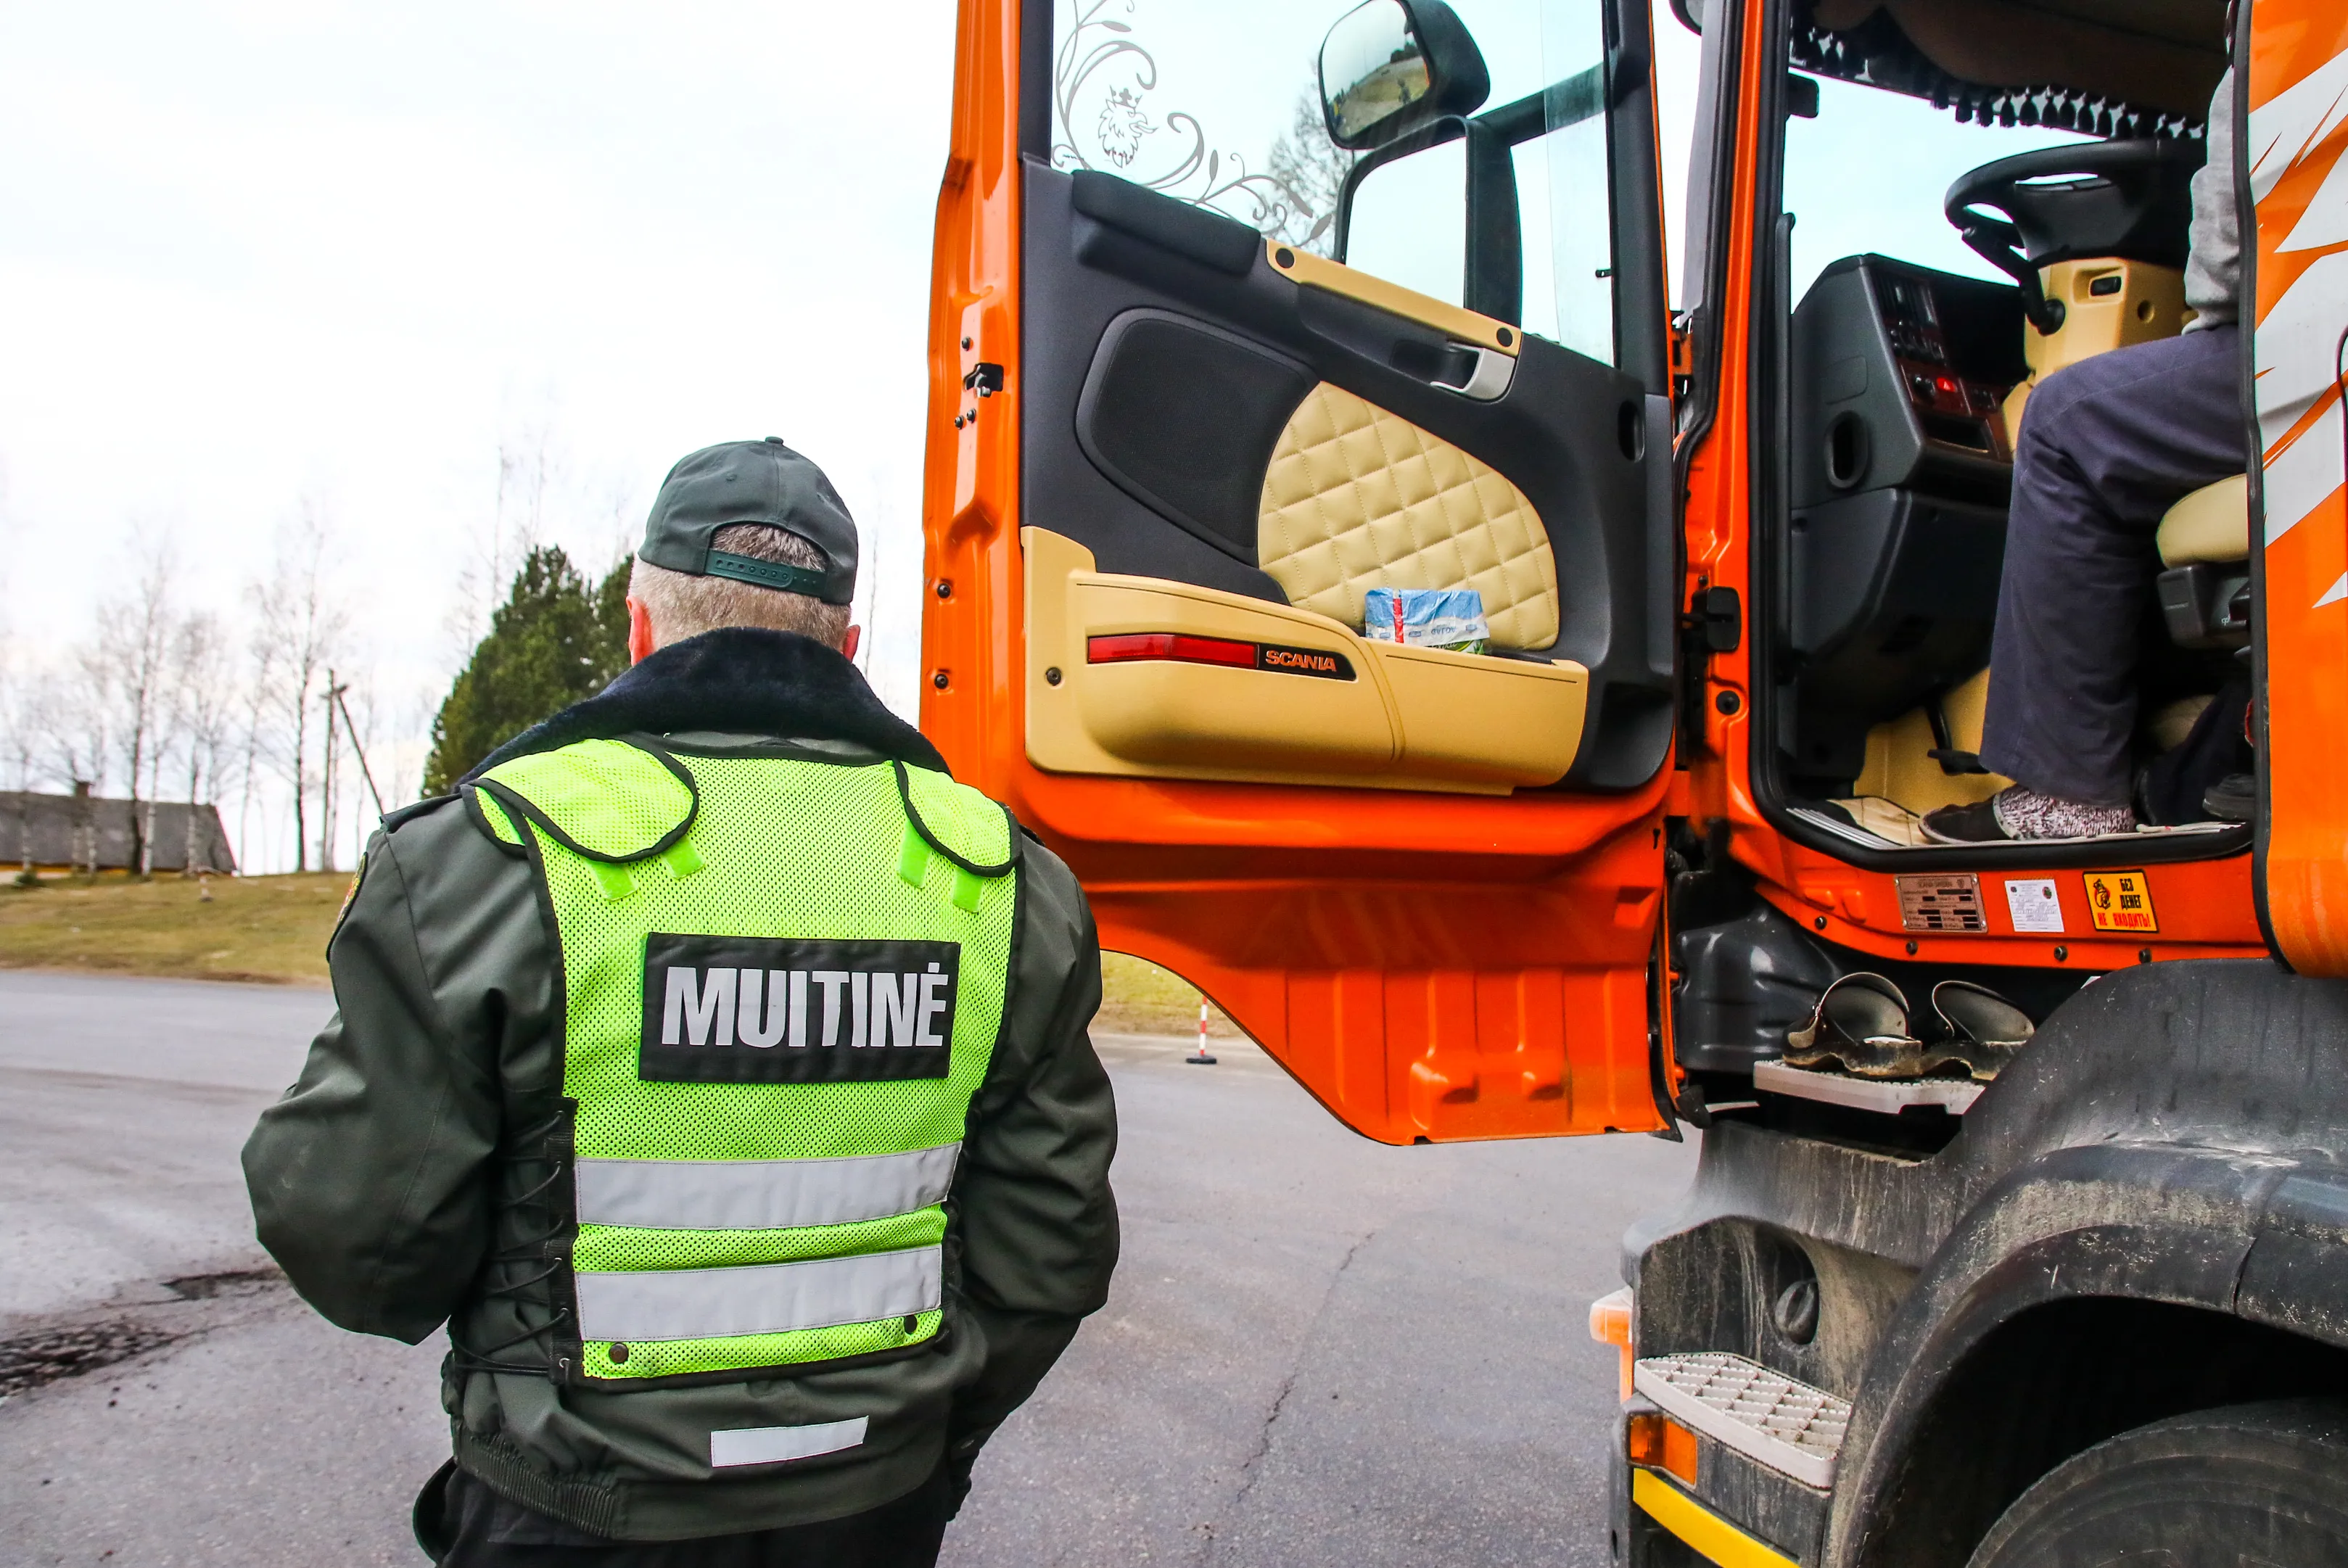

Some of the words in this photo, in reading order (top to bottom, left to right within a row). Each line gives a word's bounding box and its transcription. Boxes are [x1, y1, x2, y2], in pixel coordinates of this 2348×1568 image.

[1266, 650, 1336, 672] SCANIA
[2120, 878, 2134, 892] БЕЗ
[2120, 894, 2142, 910] ДЕНЕГ
[2098, 912, 2108, 926] НЕ
[2112, 912, 2151, 929] ВХОДИТЬ!
[662, 962, 949, 1047] MUITINĖ
